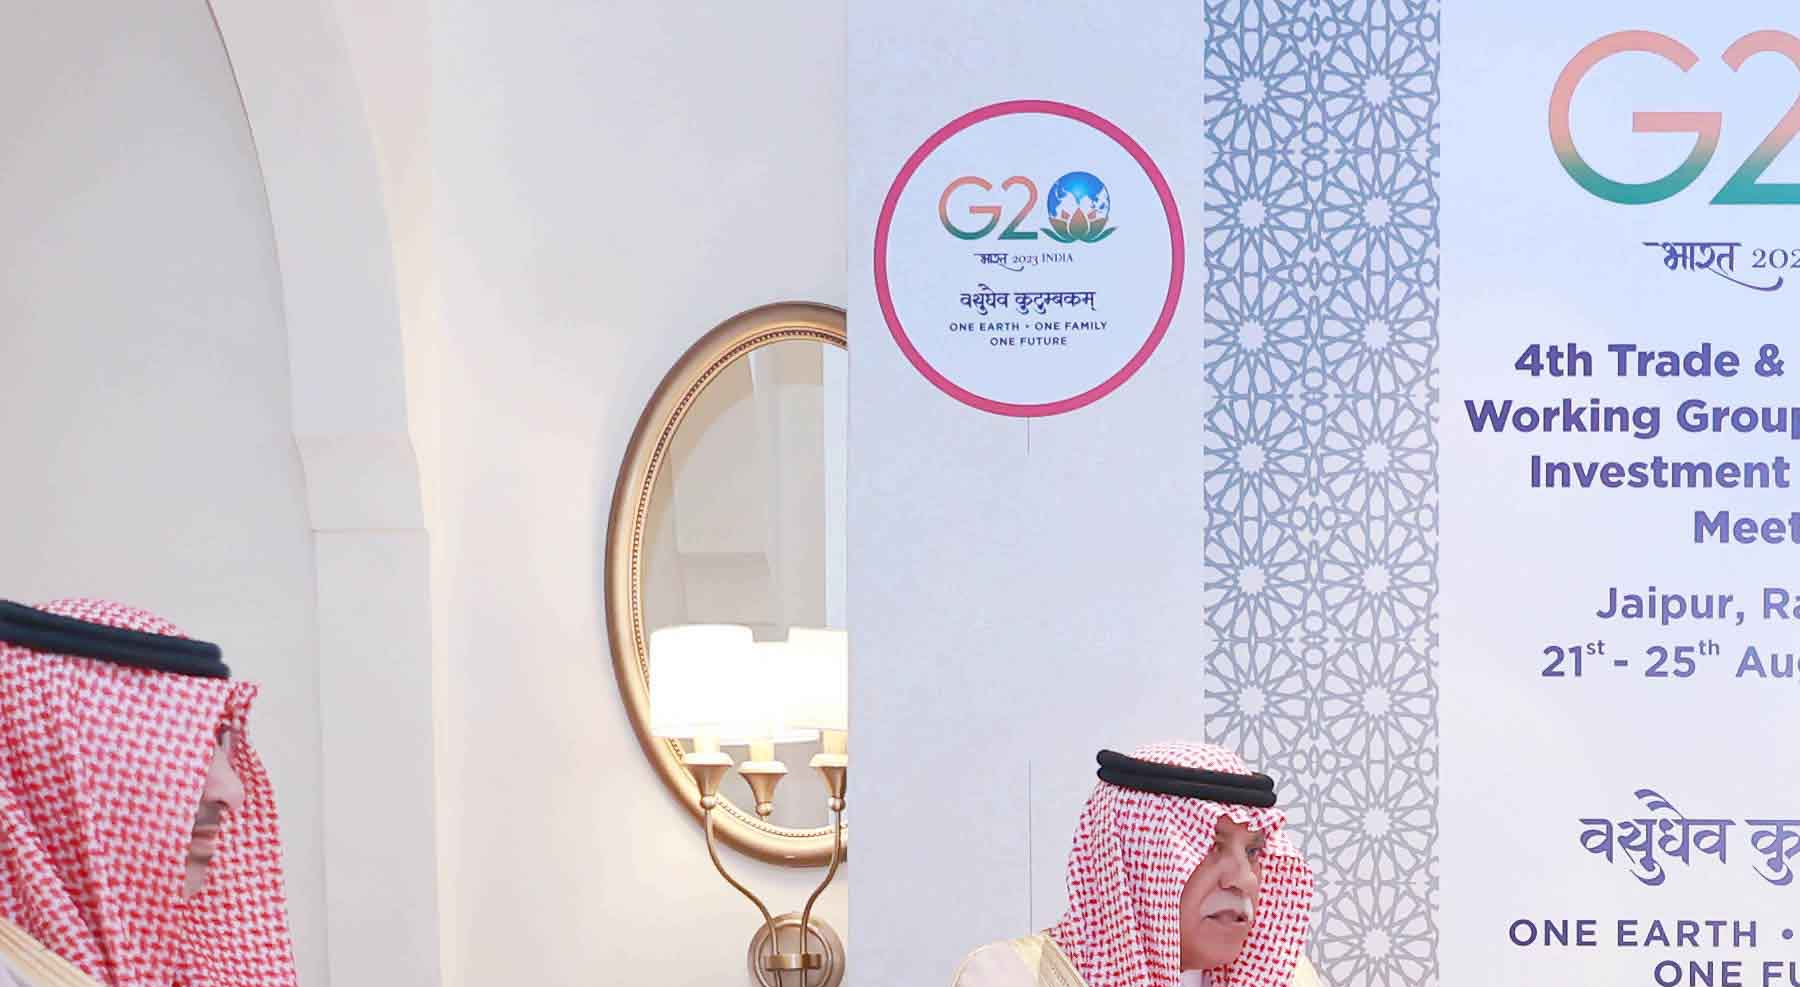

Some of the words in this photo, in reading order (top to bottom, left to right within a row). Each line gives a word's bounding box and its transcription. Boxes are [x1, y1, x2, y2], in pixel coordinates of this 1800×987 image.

[938, 171, 1117, 244] G20
[1041, 253, 1074, 263] INDIA
[949, 322, 975, 332] ONE
[979, 322, 1020, 331] EARTH
[1034, 321, 1060, 331] ONE
[1064, 321, 1108, 331] FAMILY
[989, 336, 1015, 347] ONE
[1019, 336, 1068, 346] FUTURE
[1514, 342, 1593, 378] 4th
[1607, 342, 1741, 378] Trade
[1754, 343, 1785, 378] &
[1463, 397, 1661, 440] Working
[1530, 454, 1791, 489] Investment
[1596, 585, 1746, 627] Jaipur,
[1541, 639, 1606, 678] 21st
[1644, 639, 1720, 678] 25th
[1508, 918, 1598, 947] ONE
[1616, 919, 1758, 948] EARTH
[1653, 959, 1743, 987] ONE
